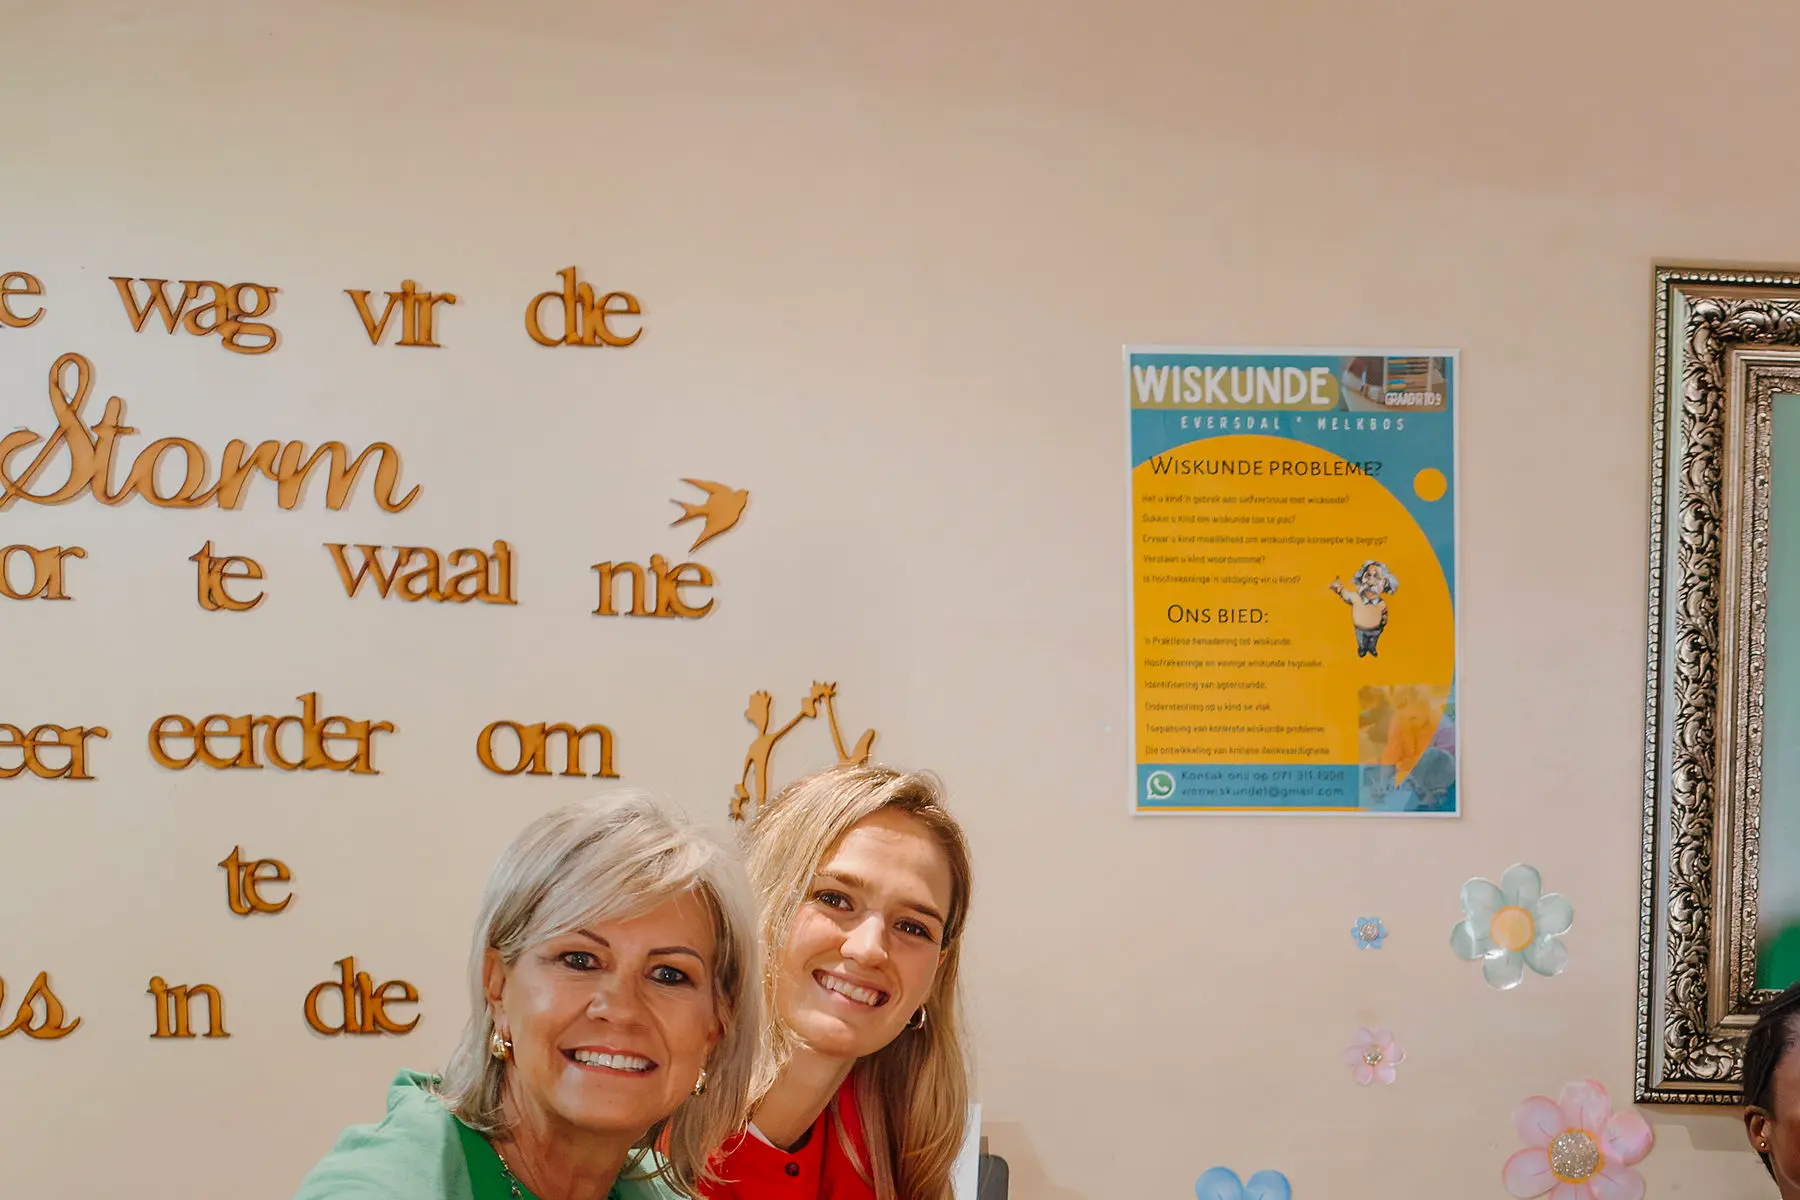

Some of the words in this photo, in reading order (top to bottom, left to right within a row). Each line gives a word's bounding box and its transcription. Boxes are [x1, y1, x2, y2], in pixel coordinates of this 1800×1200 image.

[109, 276, 278, 354] wag
[344, 279, 457, 348] vir
[525, 266, 644, 348] die
[1132, 365, 1329, 405] WISKUNDE
[1180, 416, 1281, 430] EVERSDAL
[0, 352, 423, 513] Storm
[190, 541, 265, 612] te
[323, 539, 519, 604] waai
[591, 554, 715, 619] nie
[149, 692, 394, 775] eerder
[476, 719, 621, 779] om
[218, 845, 294, 916] te
[147, 975, 231, 1038] in
[304, 956, 421, 1037] die
